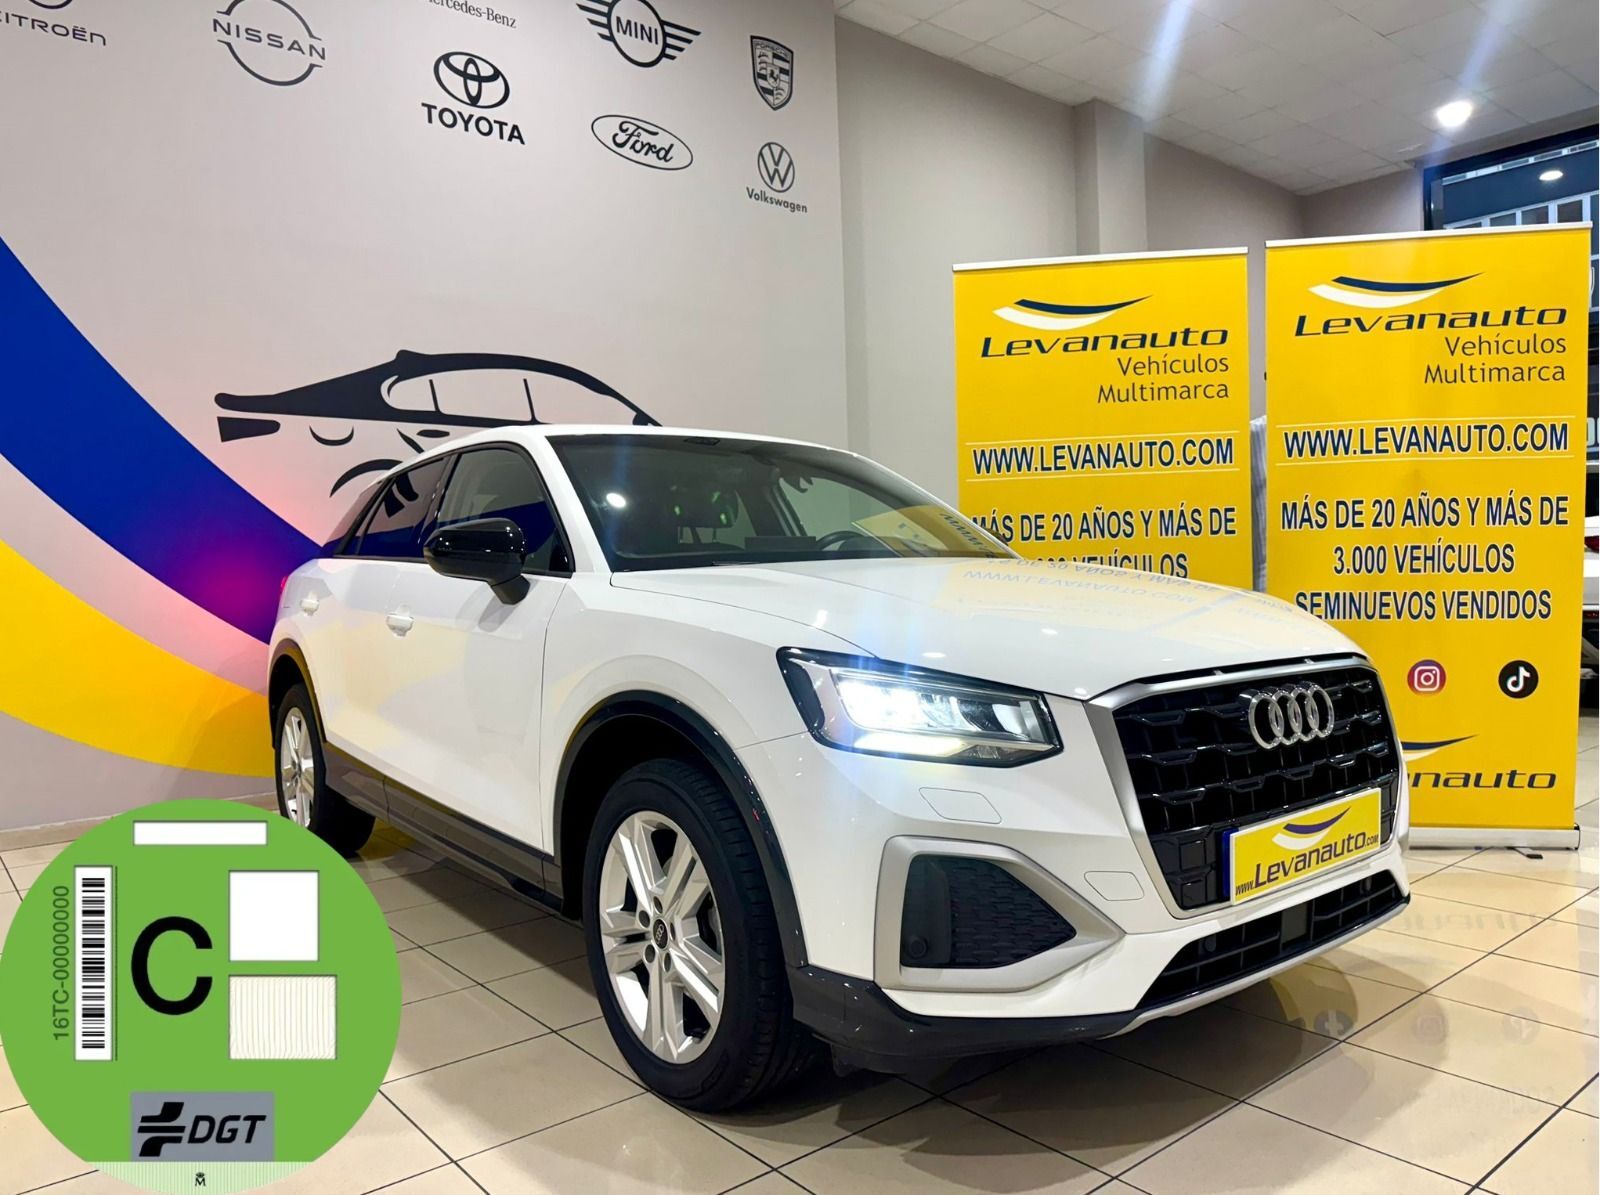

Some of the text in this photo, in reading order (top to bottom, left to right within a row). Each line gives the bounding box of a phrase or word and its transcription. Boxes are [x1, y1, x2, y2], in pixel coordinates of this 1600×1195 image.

[0, 11, 106, 46] ITROËN
[212, 18, 326, 61] NISSAN
[615, 16, 659, 45] MINI
[421, 102, 526, 145] TOYOTA
[611, 120, 675, 164] Ford
[746, 186, 808, 213] Volkswagen
[1295, 305, 1568, 337] Levanauto
[981, 326, 1229, 358] Levanauto
[1444, 332, 1567, 357] Vehículos
[1117, 353, 1229, 377] Vehículos
[1424, 362, 1566, 385] Multimarca
[1097, 381, 1230, 404] Multimarca
[972, 437, 1234, 475] WWW.LEVANAUTO.COM
[1283, 422, 1569, 458] WWW.LEVANAUTO.COM
[1020, 513, 1046, 542] DE
[1051, 512, 1073, 541] 20
[1079, 505, 1135, 540] AÑOS
[1140, 510, 1154, 538] Y
[1159, 501, 1202, 538] MÁS
[1210, 507, 1237, 536] DE
[1281, 488, 1569, 530] MÁS DE 20 AÑOS Y MÁS DE
[1333, 537, 1516, 576] 3.000 VEHÍCULOS
[1295, 590, 1437, 622] SEMINUEVOS
[1441, 589, 1552, 621] VENDIDOS
[1407, 769, 1557, 789] nauto
